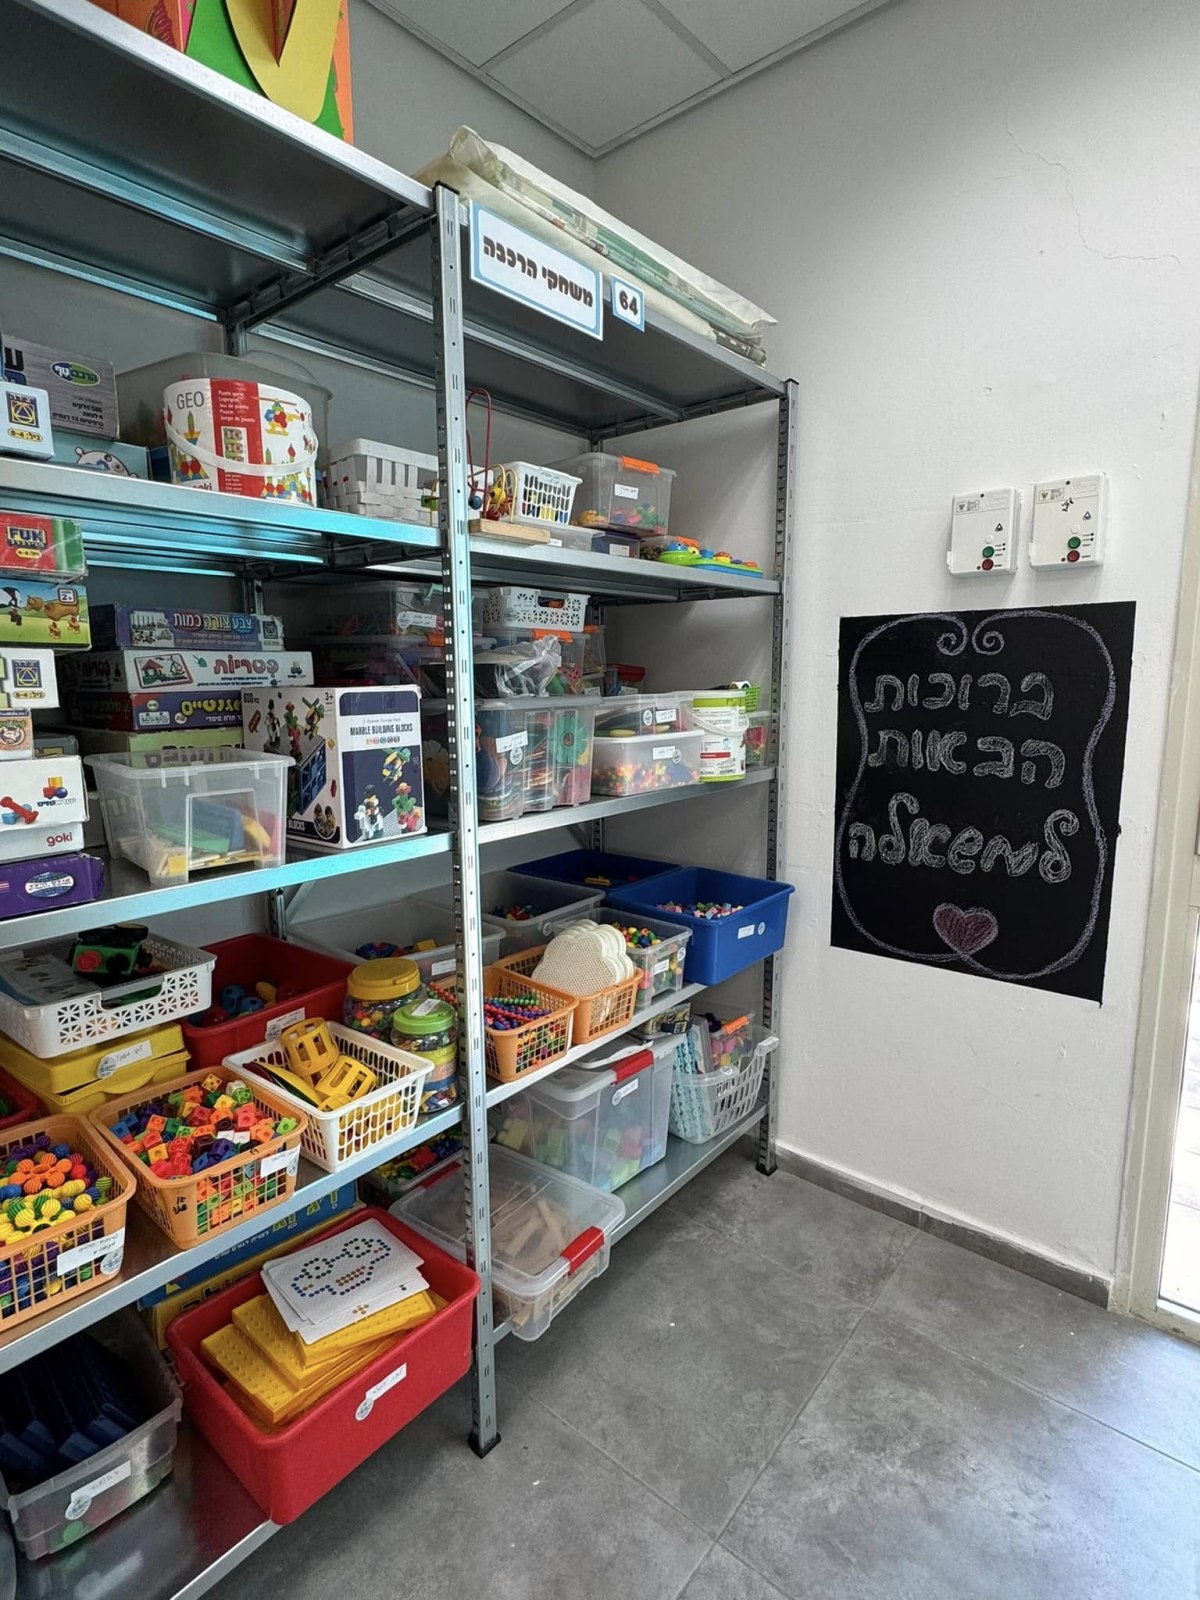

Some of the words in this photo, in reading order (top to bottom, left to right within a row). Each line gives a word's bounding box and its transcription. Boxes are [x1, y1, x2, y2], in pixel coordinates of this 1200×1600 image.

[482, 234, 538, 279] הרכבה
[541, 266, 594, 308] משחקי
[618, 290, 639, 316] 64
[176, 390, 205, 410] GEO
[9, 527, 43, 543] FUN
[173, 611, 201, 628] כמות
[203, 613, 230, 630] צורה
[231, 615, 253, 630] צבע
[864, 672, 1054, 720] ברוכות
[349, 726, 371, 736] MARBLE
[371, 724, 394, 734] BUILDING
[395, 723, 413, 733] BLOCKS
[867, 729, 1066, 789] הבאות
[46, 831, 73, 847] goki
